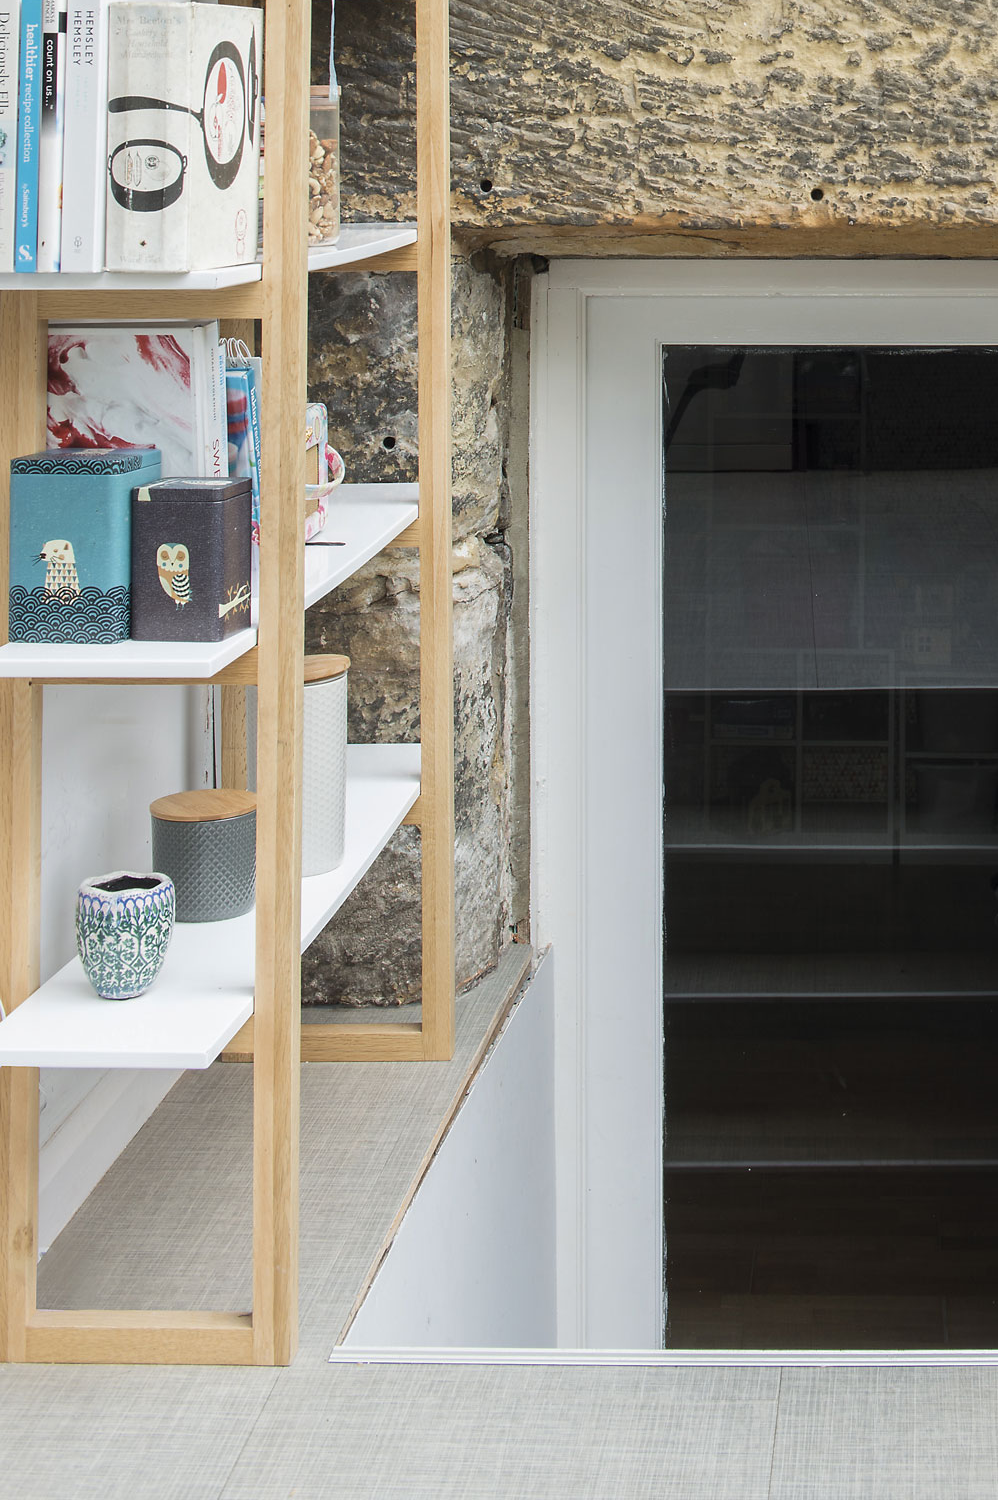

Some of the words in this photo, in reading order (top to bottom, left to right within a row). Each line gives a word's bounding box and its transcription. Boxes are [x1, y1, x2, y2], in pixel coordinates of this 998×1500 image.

[0, 12, 10, 86] Deliciously
[25, 23, 38, 81] healthier
[45, 39, 54, 67] count
[73, 10, 82, 66] HEMSLEY
[85, 10, 94, 66] HEMSLEY
[45, 70, 53, 83] on
[0, 91, 9, 115] Ella
[23, 83, 34, 113] recipe
[23, 115, 35, 163] collection
[20, 189, 30, 228] Sainsbury's
[250, 386, 258, 425] baking
[253, 425, 261, 454] recipe
